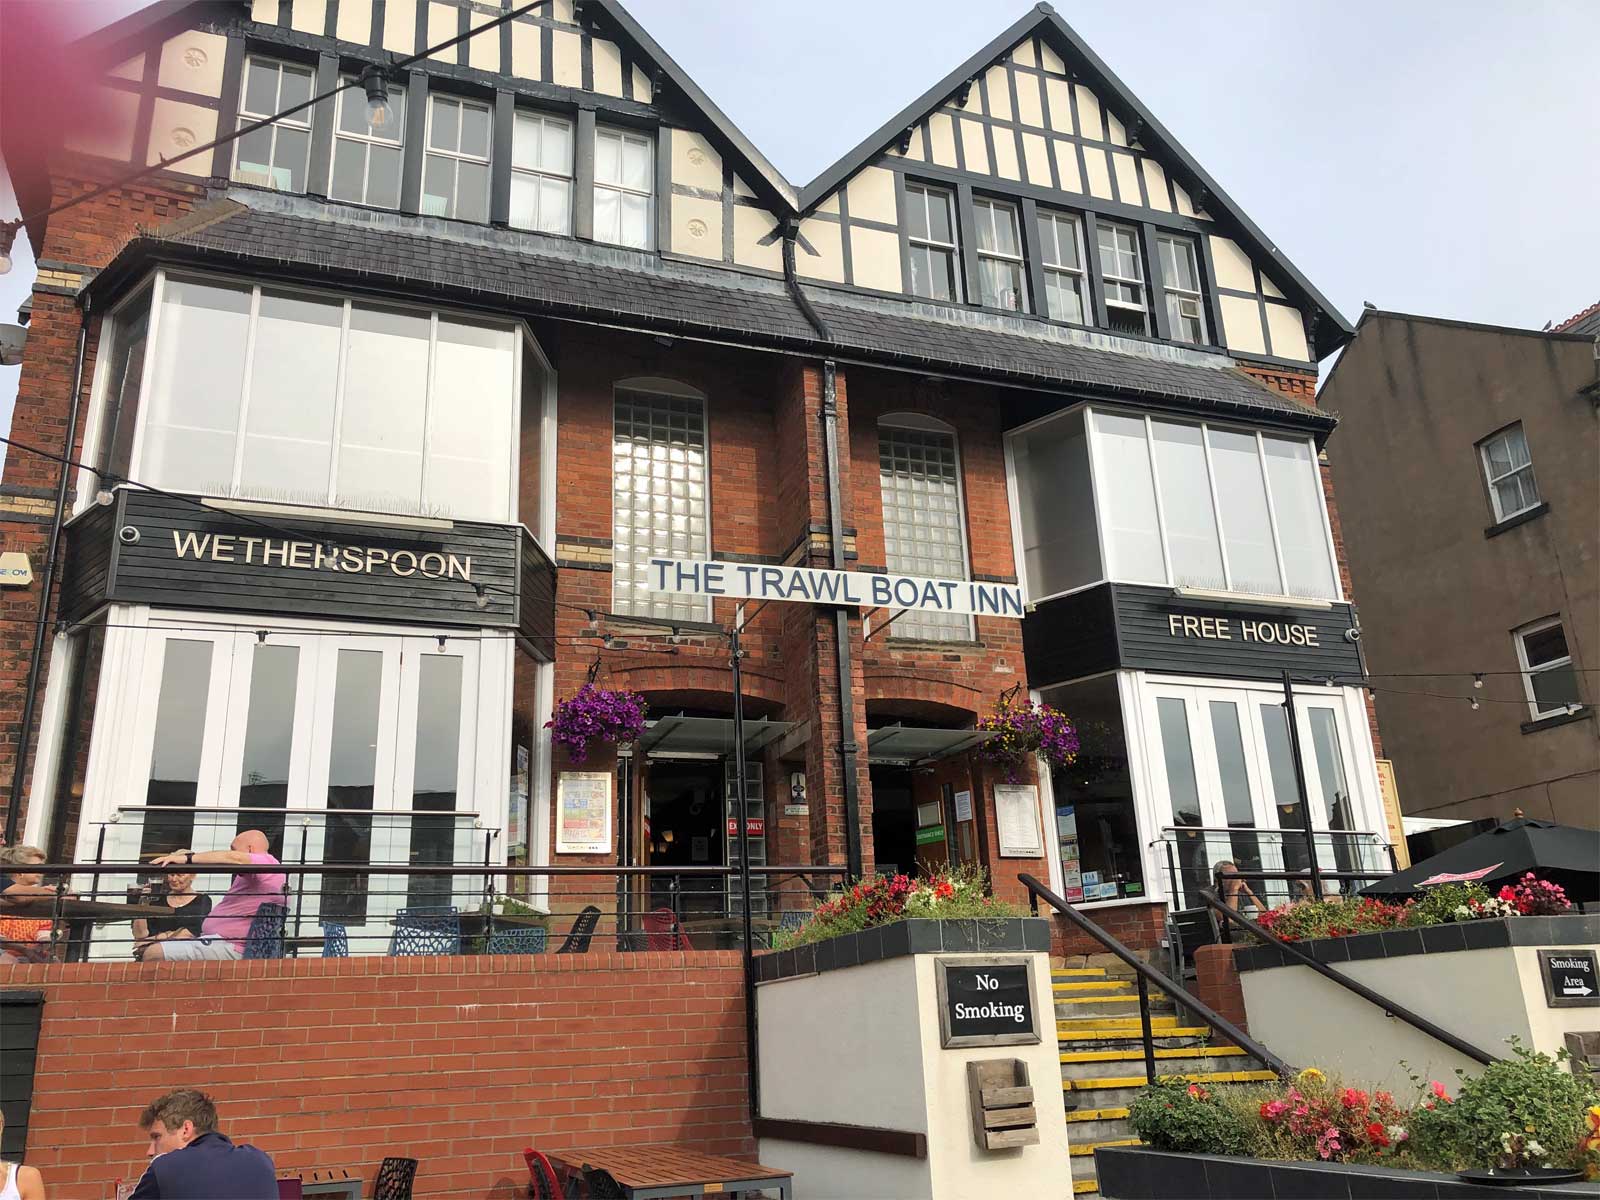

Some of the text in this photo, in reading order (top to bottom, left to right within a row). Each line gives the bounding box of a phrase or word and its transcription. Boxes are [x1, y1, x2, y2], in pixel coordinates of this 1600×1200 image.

[173, 530, 472, 581] WETHERSPOON
[651, 558, 1023, 616] THE TRAWL BOAT INN
[1168, 614, 1320, 647] FREE HOUSE
[1551, 958, 1590, 972] Smoking
[975, 974, 999, 990] No
[1563, 976, 1584, 986] Area
[955, 1002, 1025, 1022] Smoking
